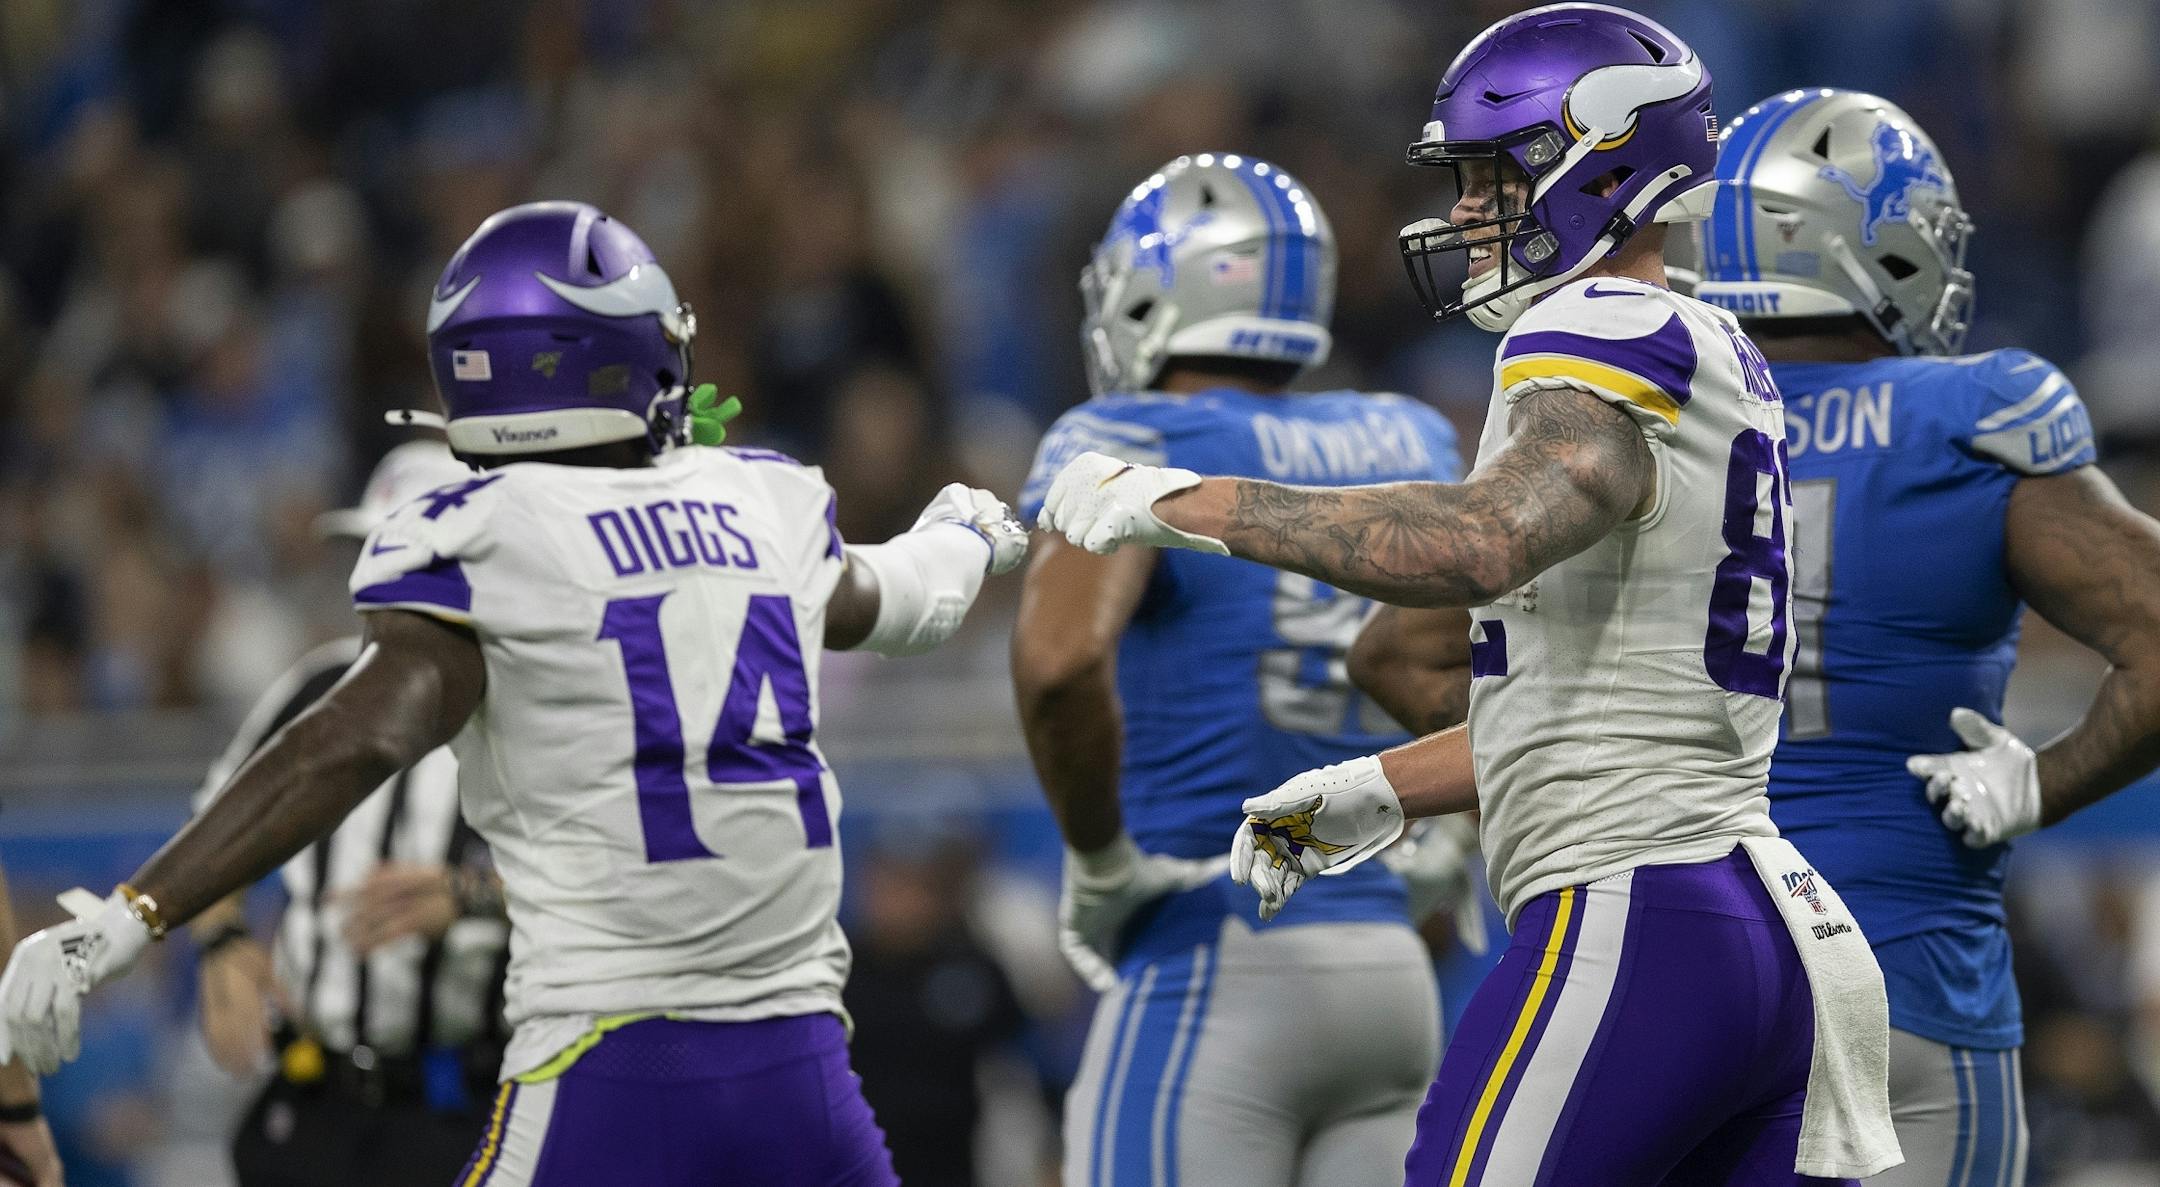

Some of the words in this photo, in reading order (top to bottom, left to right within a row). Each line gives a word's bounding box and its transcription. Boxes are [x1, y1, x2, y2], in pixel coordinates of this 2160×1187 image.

[587, 500, 759, 577] DIGGS
[1704, 428, 1799, 700] 8
[596, 590, 834, 864] 14
[1811, 922, 1848, 941] Wilson
